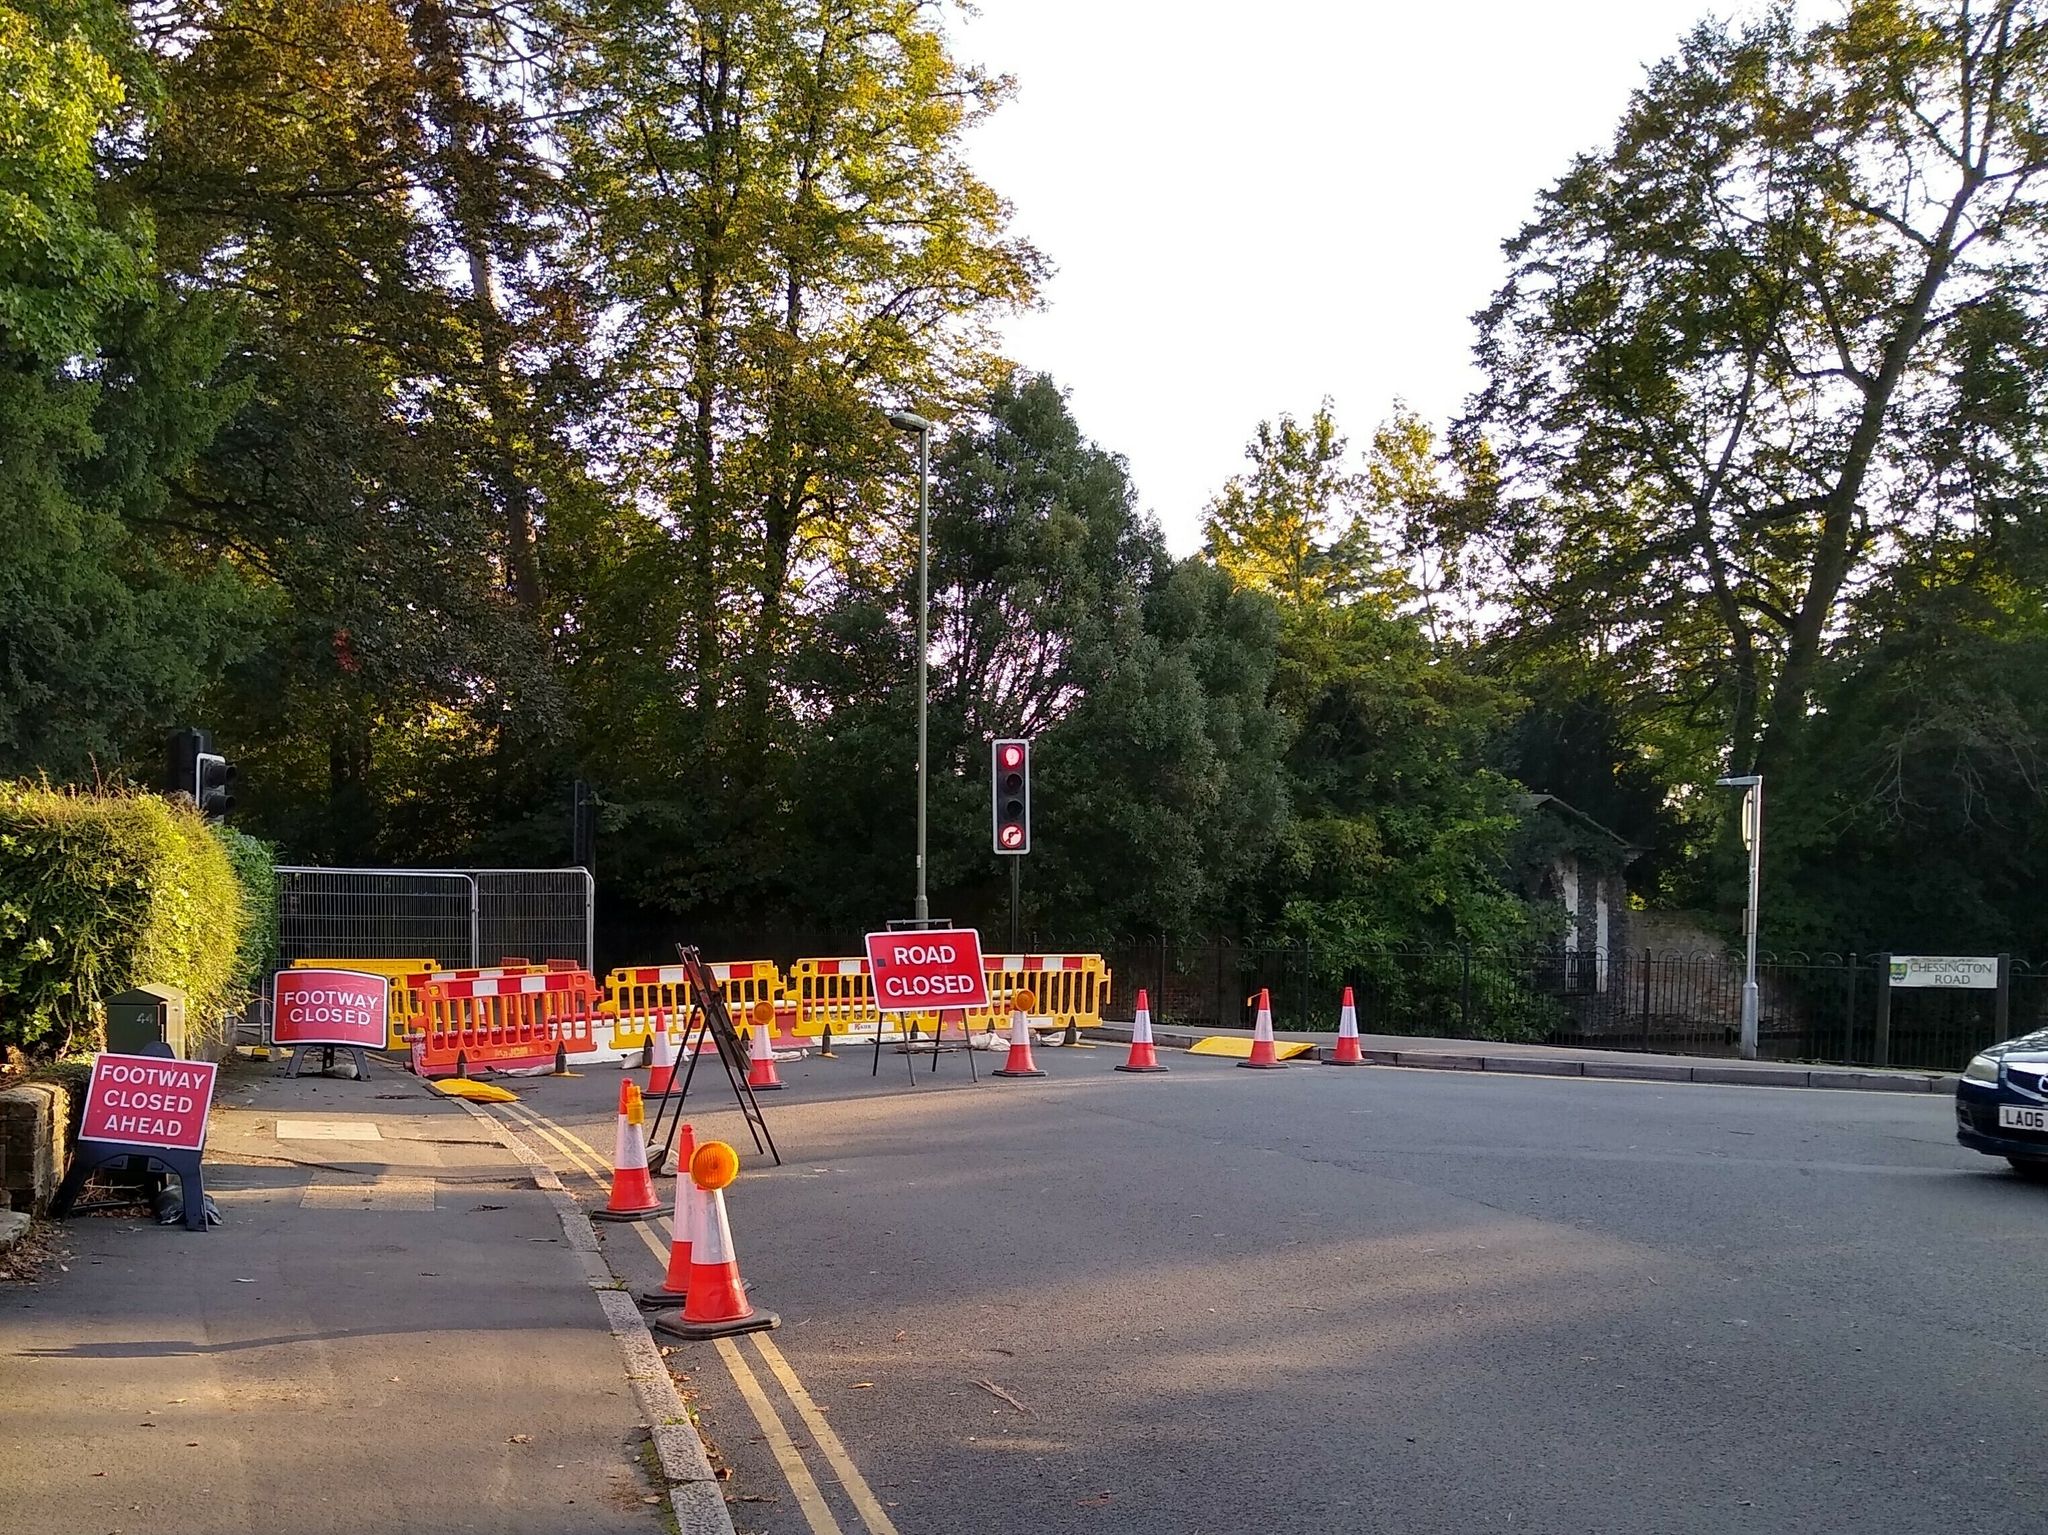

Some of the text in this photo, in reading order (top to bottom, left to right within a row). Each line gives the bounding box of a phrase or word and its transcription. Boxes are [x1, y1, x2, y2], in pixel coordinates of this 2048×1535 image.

[893, 945, 956, 966] ROAD
[1910, 962, 1993, 974] CHESSINGTON
[885, 974, 975, 997] CLOSED
[1934, 974, 1971, 985] ROAD
[284, 990, 379, 1010] FOOTWAY
[136, 1012, 153, 1024] 44
[289, 1007, 371, 1026] CLOSED
[99, 1064, 207, 1090] FOOTWAY
[103, 1089, 193, 1114] CLOSED
[103, 1114, 182, 1137] AHEAD
[2005, 1109, 2045, 1128] LA06
